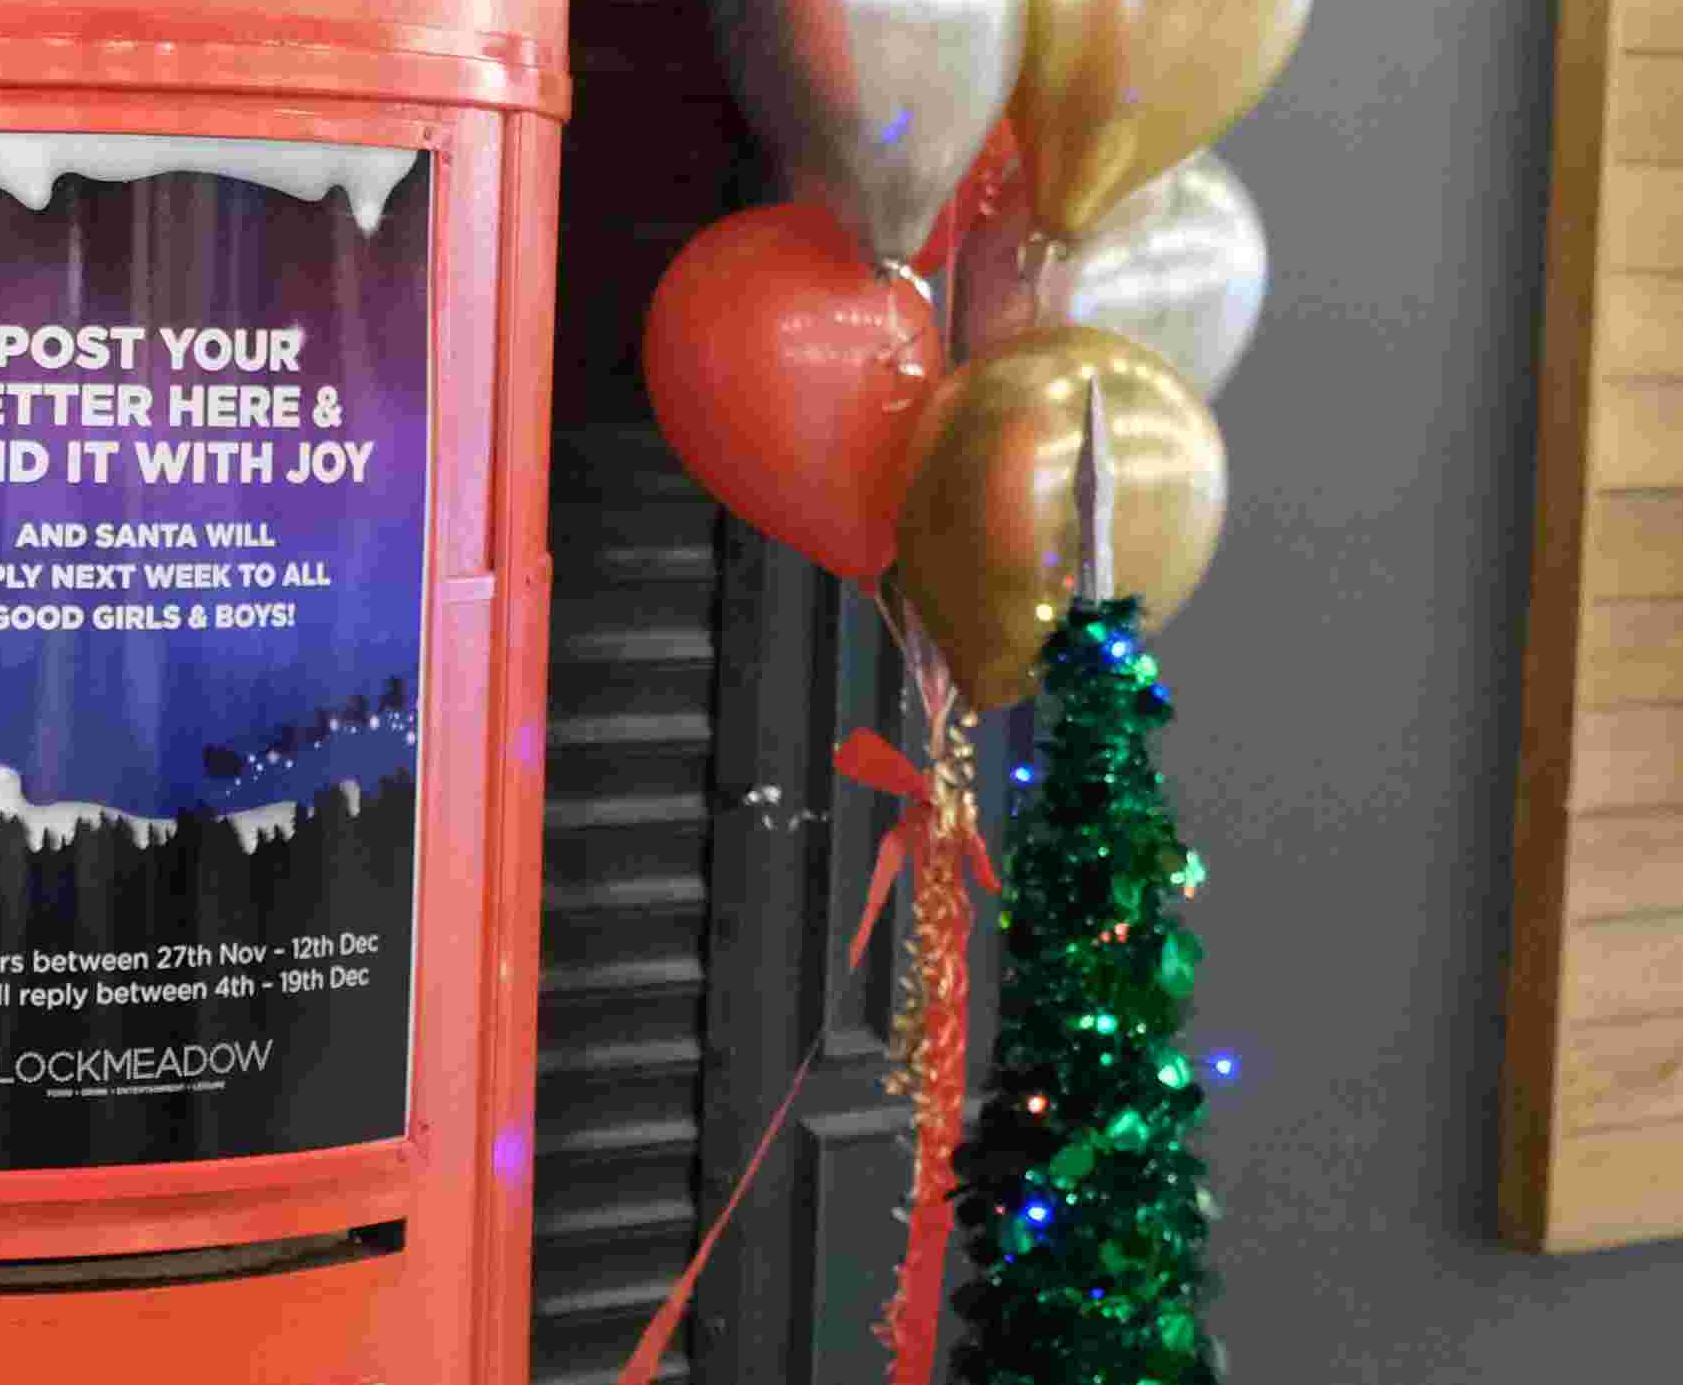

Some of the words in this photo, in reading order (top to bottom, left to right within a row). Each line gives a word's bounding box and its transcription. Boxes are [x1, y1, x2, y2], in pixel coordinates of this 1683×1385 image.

[159, 326, 302, 372] YOUR
[169, 384, 301, 428] HERE
[312, 385, 343, 429] &
[66, 440, 120, 484] IT
[133, 440, 273, 485] WITH
[285, 440, 375, 485] JOY
[14, 522, 88, 549] AND
[94, 522, 198, 549] SANTA
[204, 522, 276, 548] WILL
[51, 563, 137, 590] NEXT
[143, 562, 233, 589] WEEK
[237, 563, 277, 588] TO
[281, 561, 331, 587] ALL
[92, 604, 182, 631] GIRLS
[187, 604, 208, 630] &
[214, 602, 297, 629] BOYS!
[32, 948, 150, 974] between
[156, 944, 213, 970] 27th
[218, 942, 267, 966] Nov
[290, 934, 335, 960] 12th
[339, 932, 380, 957] Dec
[19, 981, 89, 1011] reply
[96, 979, 208, 1006] between
[214, 975, 256, 999] 4th
[278, 968, 324, 994] 19th
[329, 965, 370, 990] Dec
